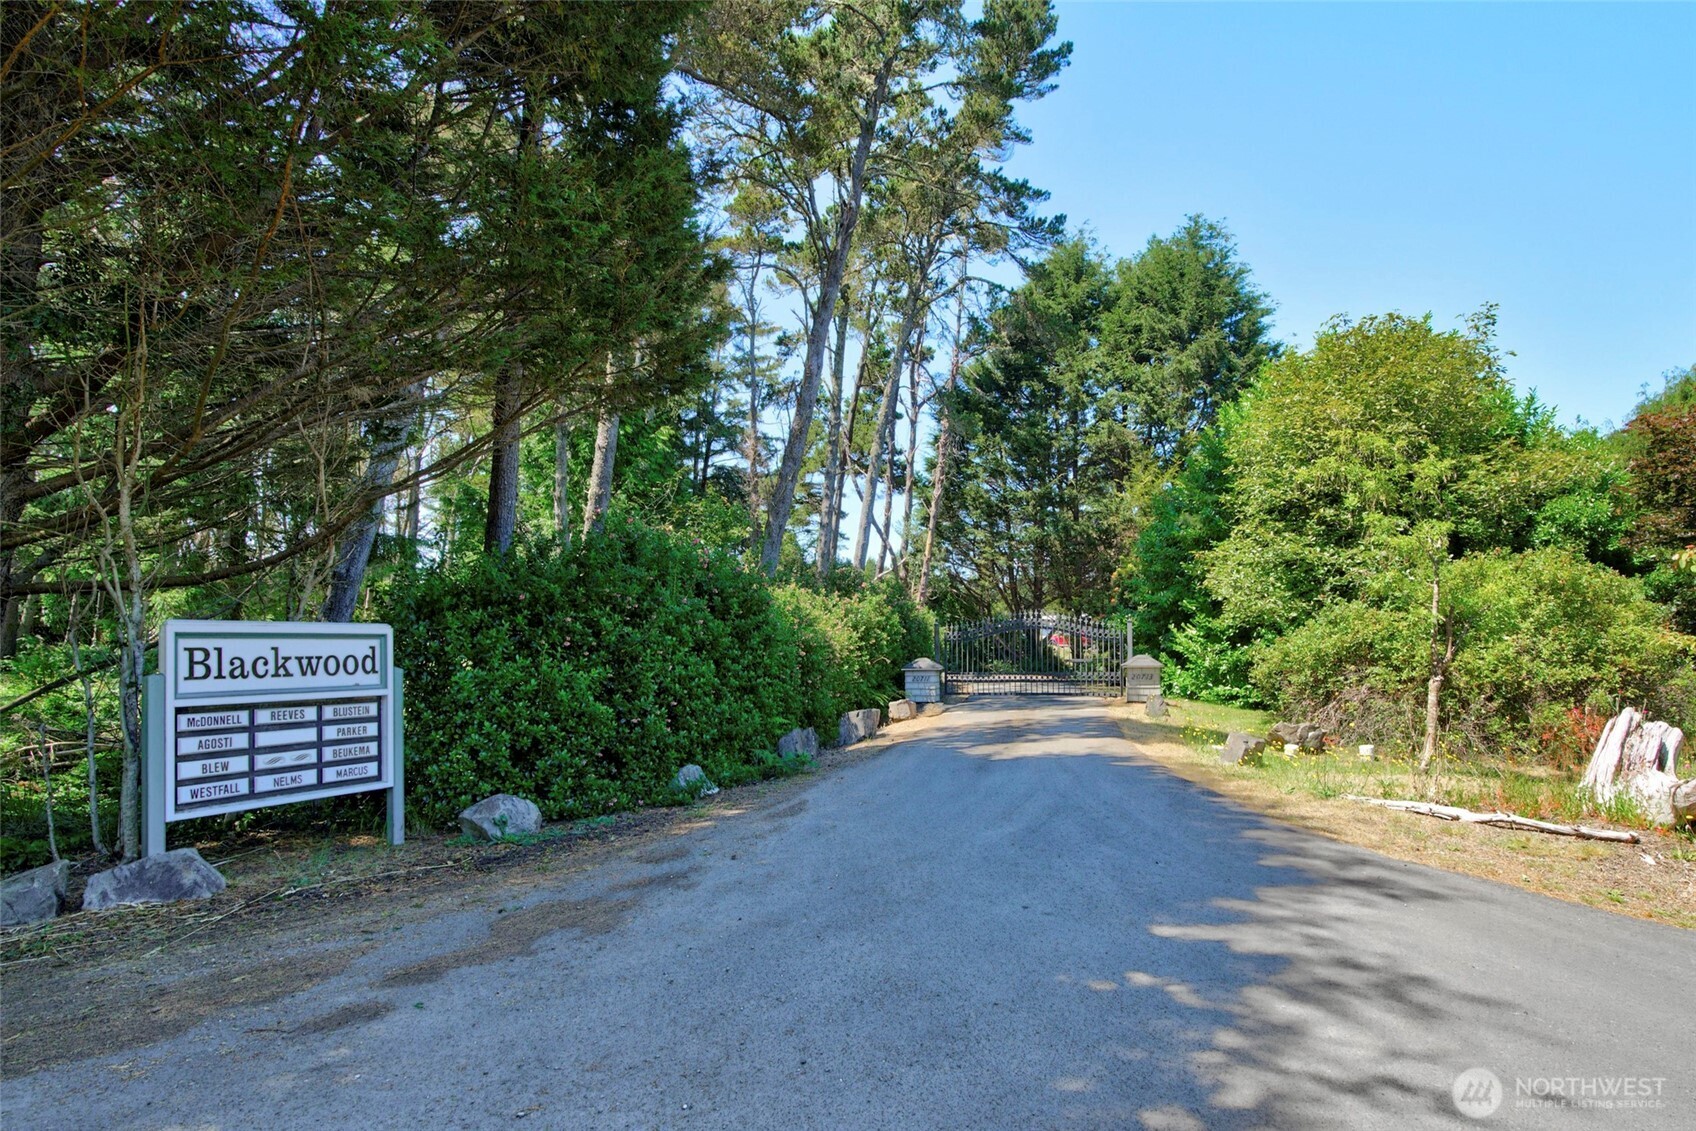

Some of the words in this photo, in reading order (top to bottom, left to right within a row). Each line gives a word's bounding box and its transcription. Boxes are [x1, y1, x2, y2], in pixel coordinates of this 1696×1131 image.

[183, 645, 379, 681] Blackwood
[270, 709, 305, 721] REEVES
[333, 705, 370, 717] BLUSTEIN
[187, 713, 242, 728] McDONNELL
[337, 725, 367, 737] PARKER
[197, 737, 233, 751] AGOSTI
[332, 745, 370, 758] BEUKEMA
[201, 760, 229, 774] BLEW
[336, 765, 368, 778] MARCUS
[273, 774, 303, 787] NELMS
[190, 783, 240, 800] WESTFALL
